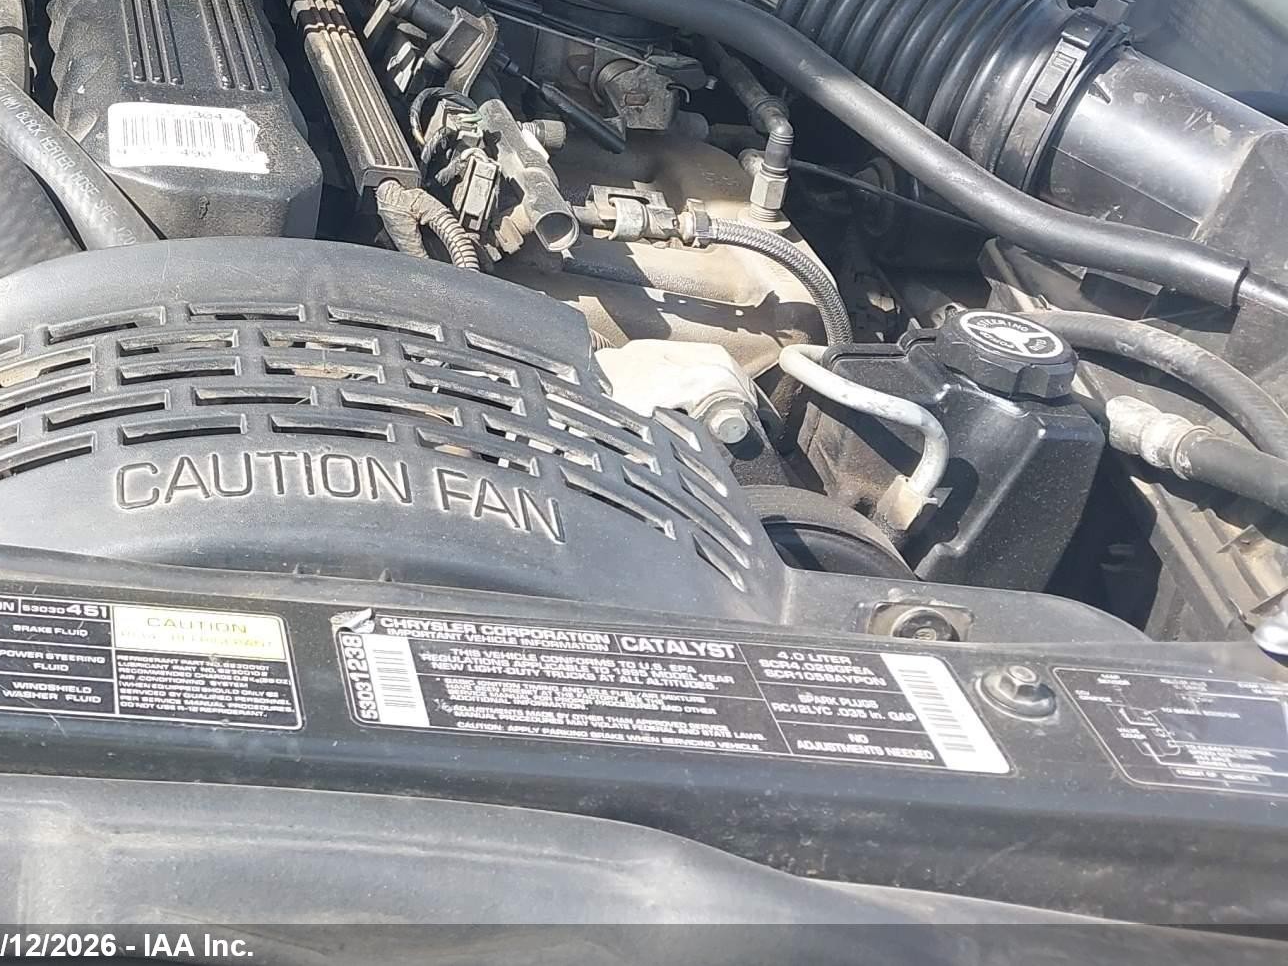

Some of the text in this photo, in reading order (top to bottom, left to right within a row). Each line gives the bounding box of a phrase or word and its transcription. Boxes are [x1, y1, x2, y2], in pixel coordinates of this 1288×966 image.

[16, 106, 45, 136] BLACK
[39, 135, 76, 171] HEATER
[71, 168, 100, 195] HOSE
[115, 450, 567, 545] CAUTION FAN
[12, 624, 89, 637] BRAKE FLUID
[147, 617, 247, 634] CAUTION
[380, 617, 611, 645] CHRYSLER CORPORATION
[386, 628, 609, 652] IMPORTANT VEHICLE INFORMATION
[620, 636, 736, 659] CATALYST
[33, 662, 70, 672] FLUID
[45, 652, 106, 664] STEERING
[422, 652, 510, 668] REGULATIONS
[512, 660, 590, 674] APPLICABLE
[651, 670, 698, 682] MODEL
[698, 673, 735, 684] YEAR
[450, 648, 697, 674] THIS VEHICLE CONFORMS TO U.S. EPA
[777, 650, 852, 665] 4.0 LITER
[341, 634, 380, 721] 53031238
[430, 661, 720, 691] NEW LIGHT-DUTY TRUCKS AT ALL ALTITUDES.
[2, 689, 102, 704] WASHER FLUID
[12, 681, 92, 694] WINDSHIELD
[797, 693, 879, 709] SPARK PLUGS
[770, 702, 833, 716] RC12LYC
[887, 711, 917, 723] GAP
[456, 721, 505, 731] CAUTION:
[507, 725, 540, 734] APPLY
[542, 727, 589, 738] PARKING
[590, 731, 625, 741] BRAKE
[626, 734, 660, 744] WHEN
[661, 737, 717, 748] SERVICING
[847, 732, 869, 744] NO
[796, 739, 935, 761] ADJUSTMENTS NEEDED
